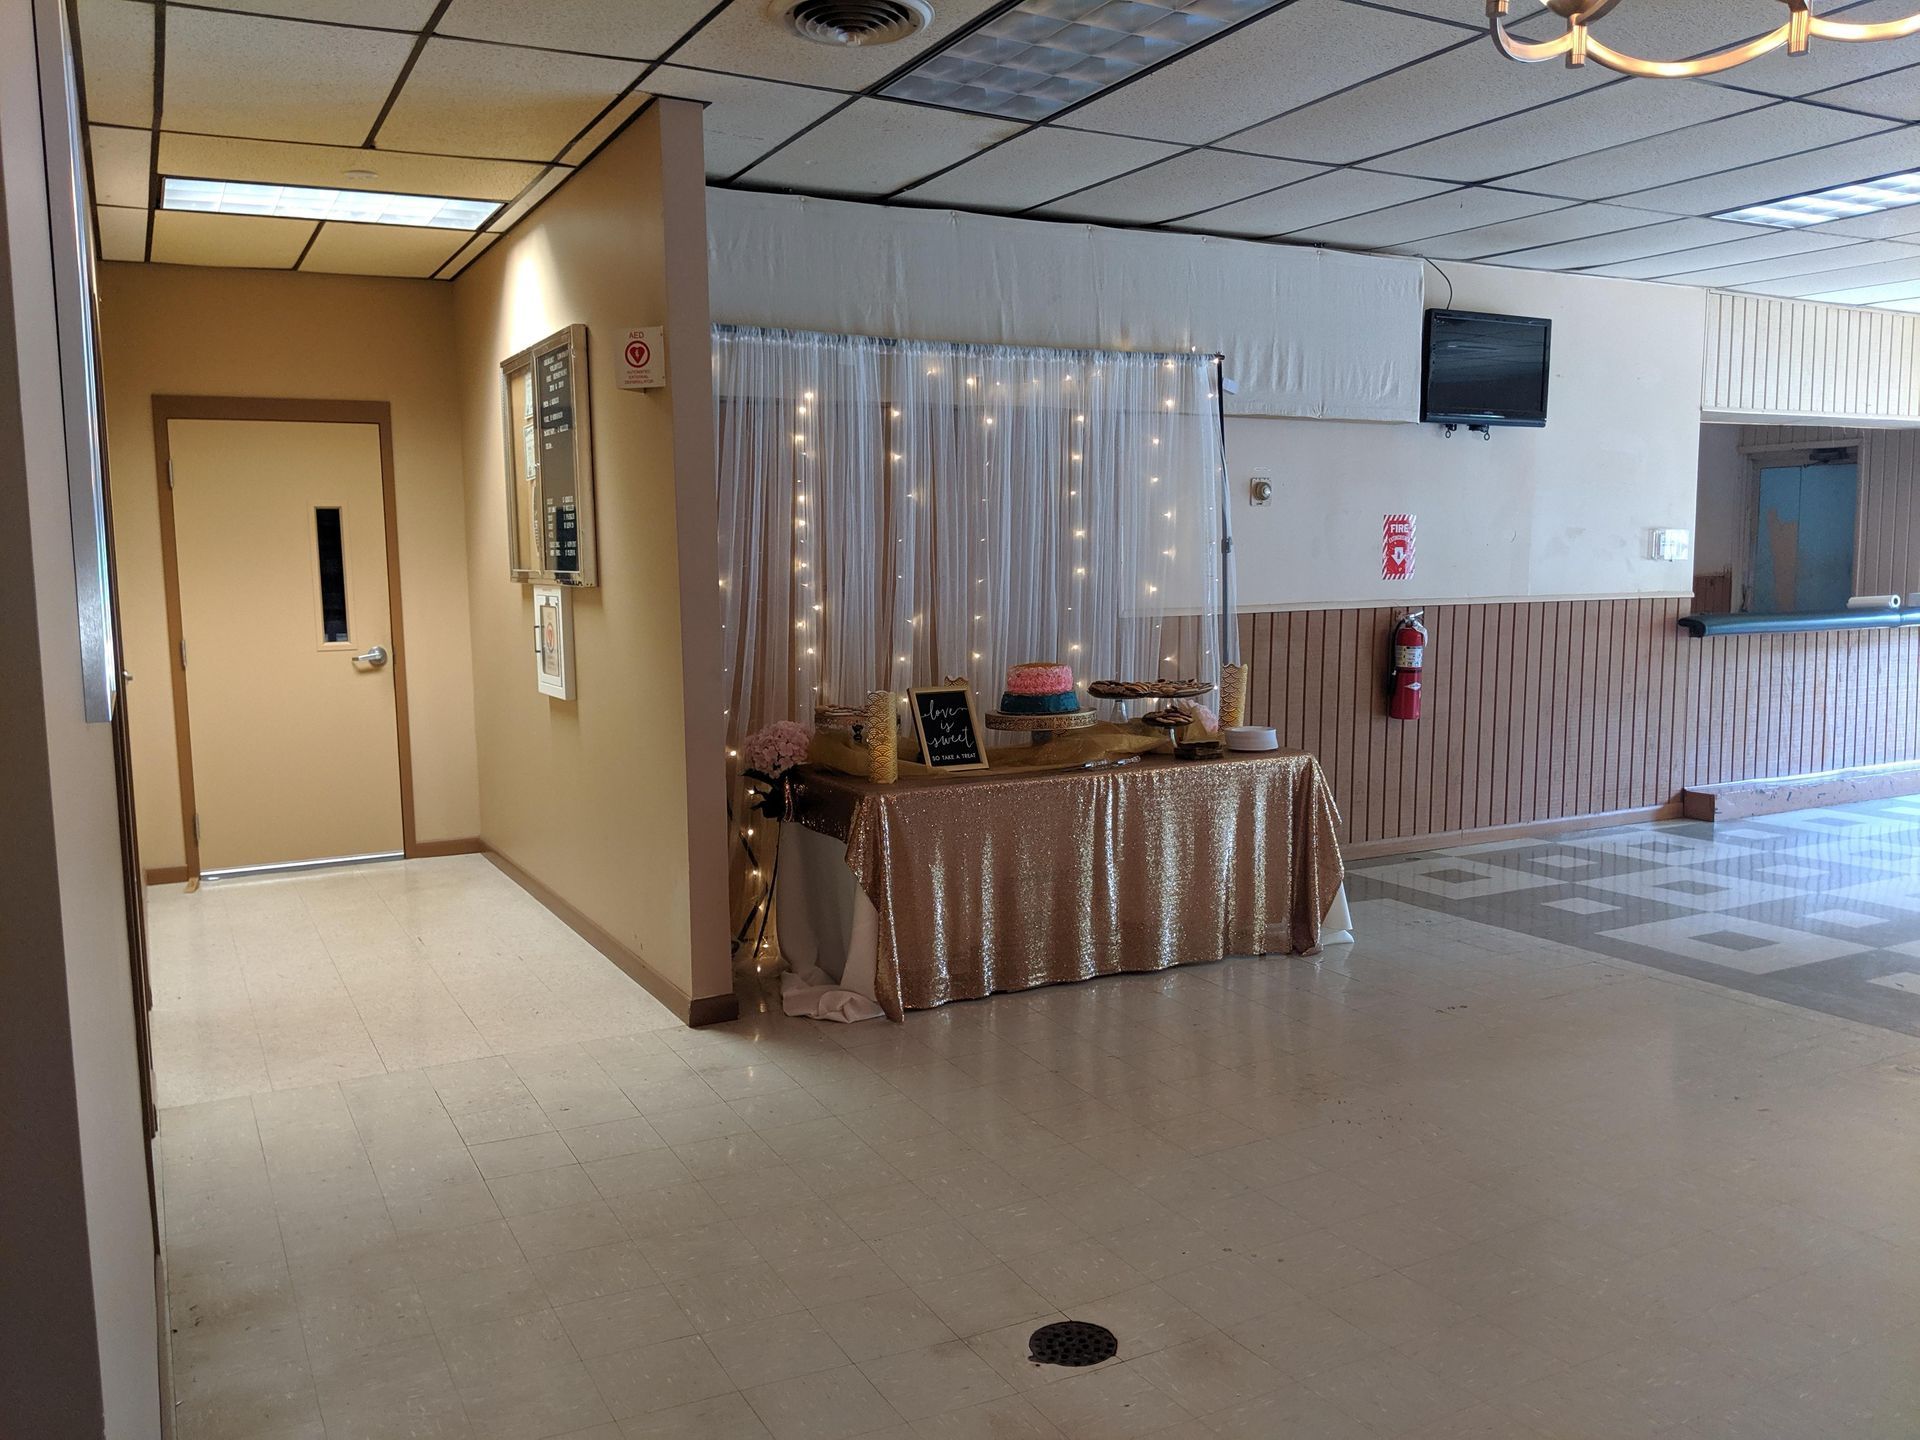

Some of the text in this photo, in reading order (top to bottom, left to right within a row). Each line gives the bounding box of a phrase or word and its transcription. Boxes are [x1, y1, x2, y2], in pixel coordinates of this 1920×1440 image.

[629, 331, 645, 339] AED
[1390, 523, 1409, 533] FIRE
[921, 699, 968, 720] love
[940, 720, 955, 733] is
[928, 725, 975, 748] sweet
